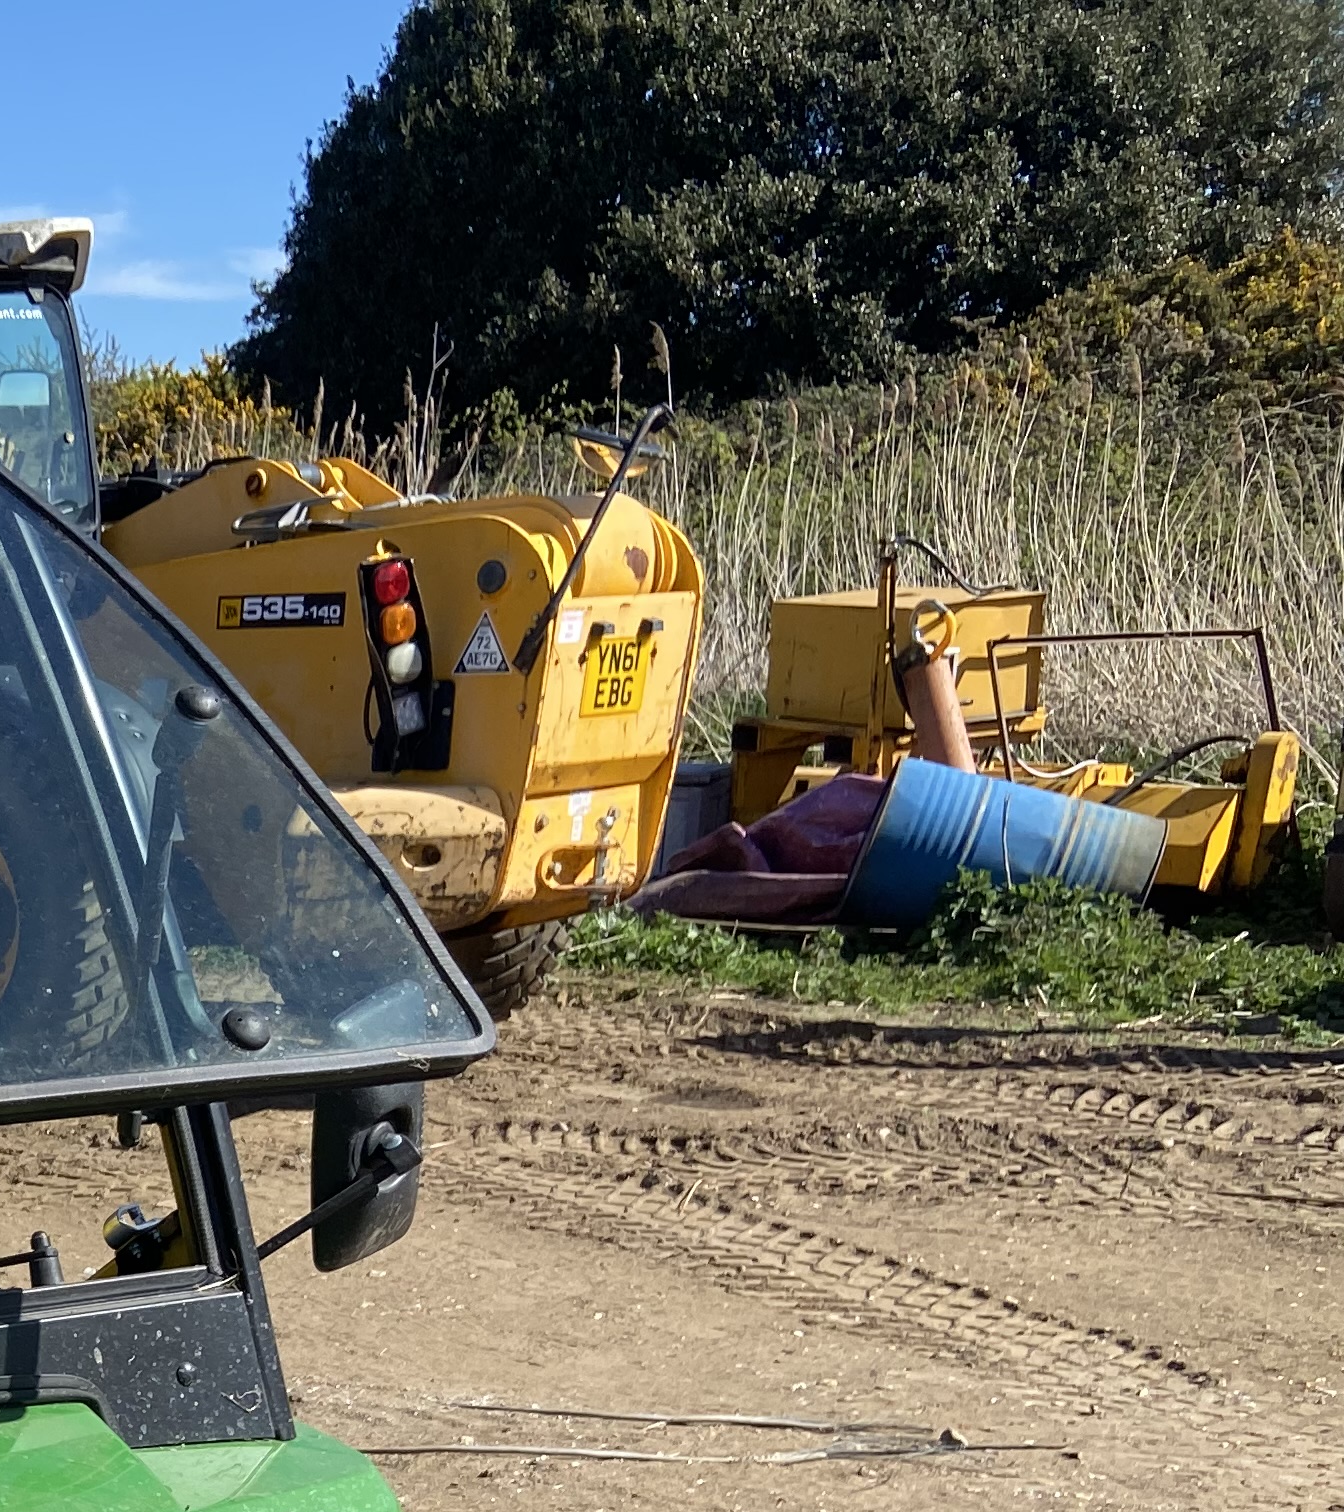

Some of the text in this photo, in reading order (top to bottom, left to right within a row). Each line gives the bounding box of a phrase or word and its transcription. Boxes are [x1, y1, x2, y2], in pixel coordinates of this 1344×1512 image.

[476, 636, 492, 650] 72
[598, 641, 641, 674] YN61
[593, 677, 634, 709] EBG
